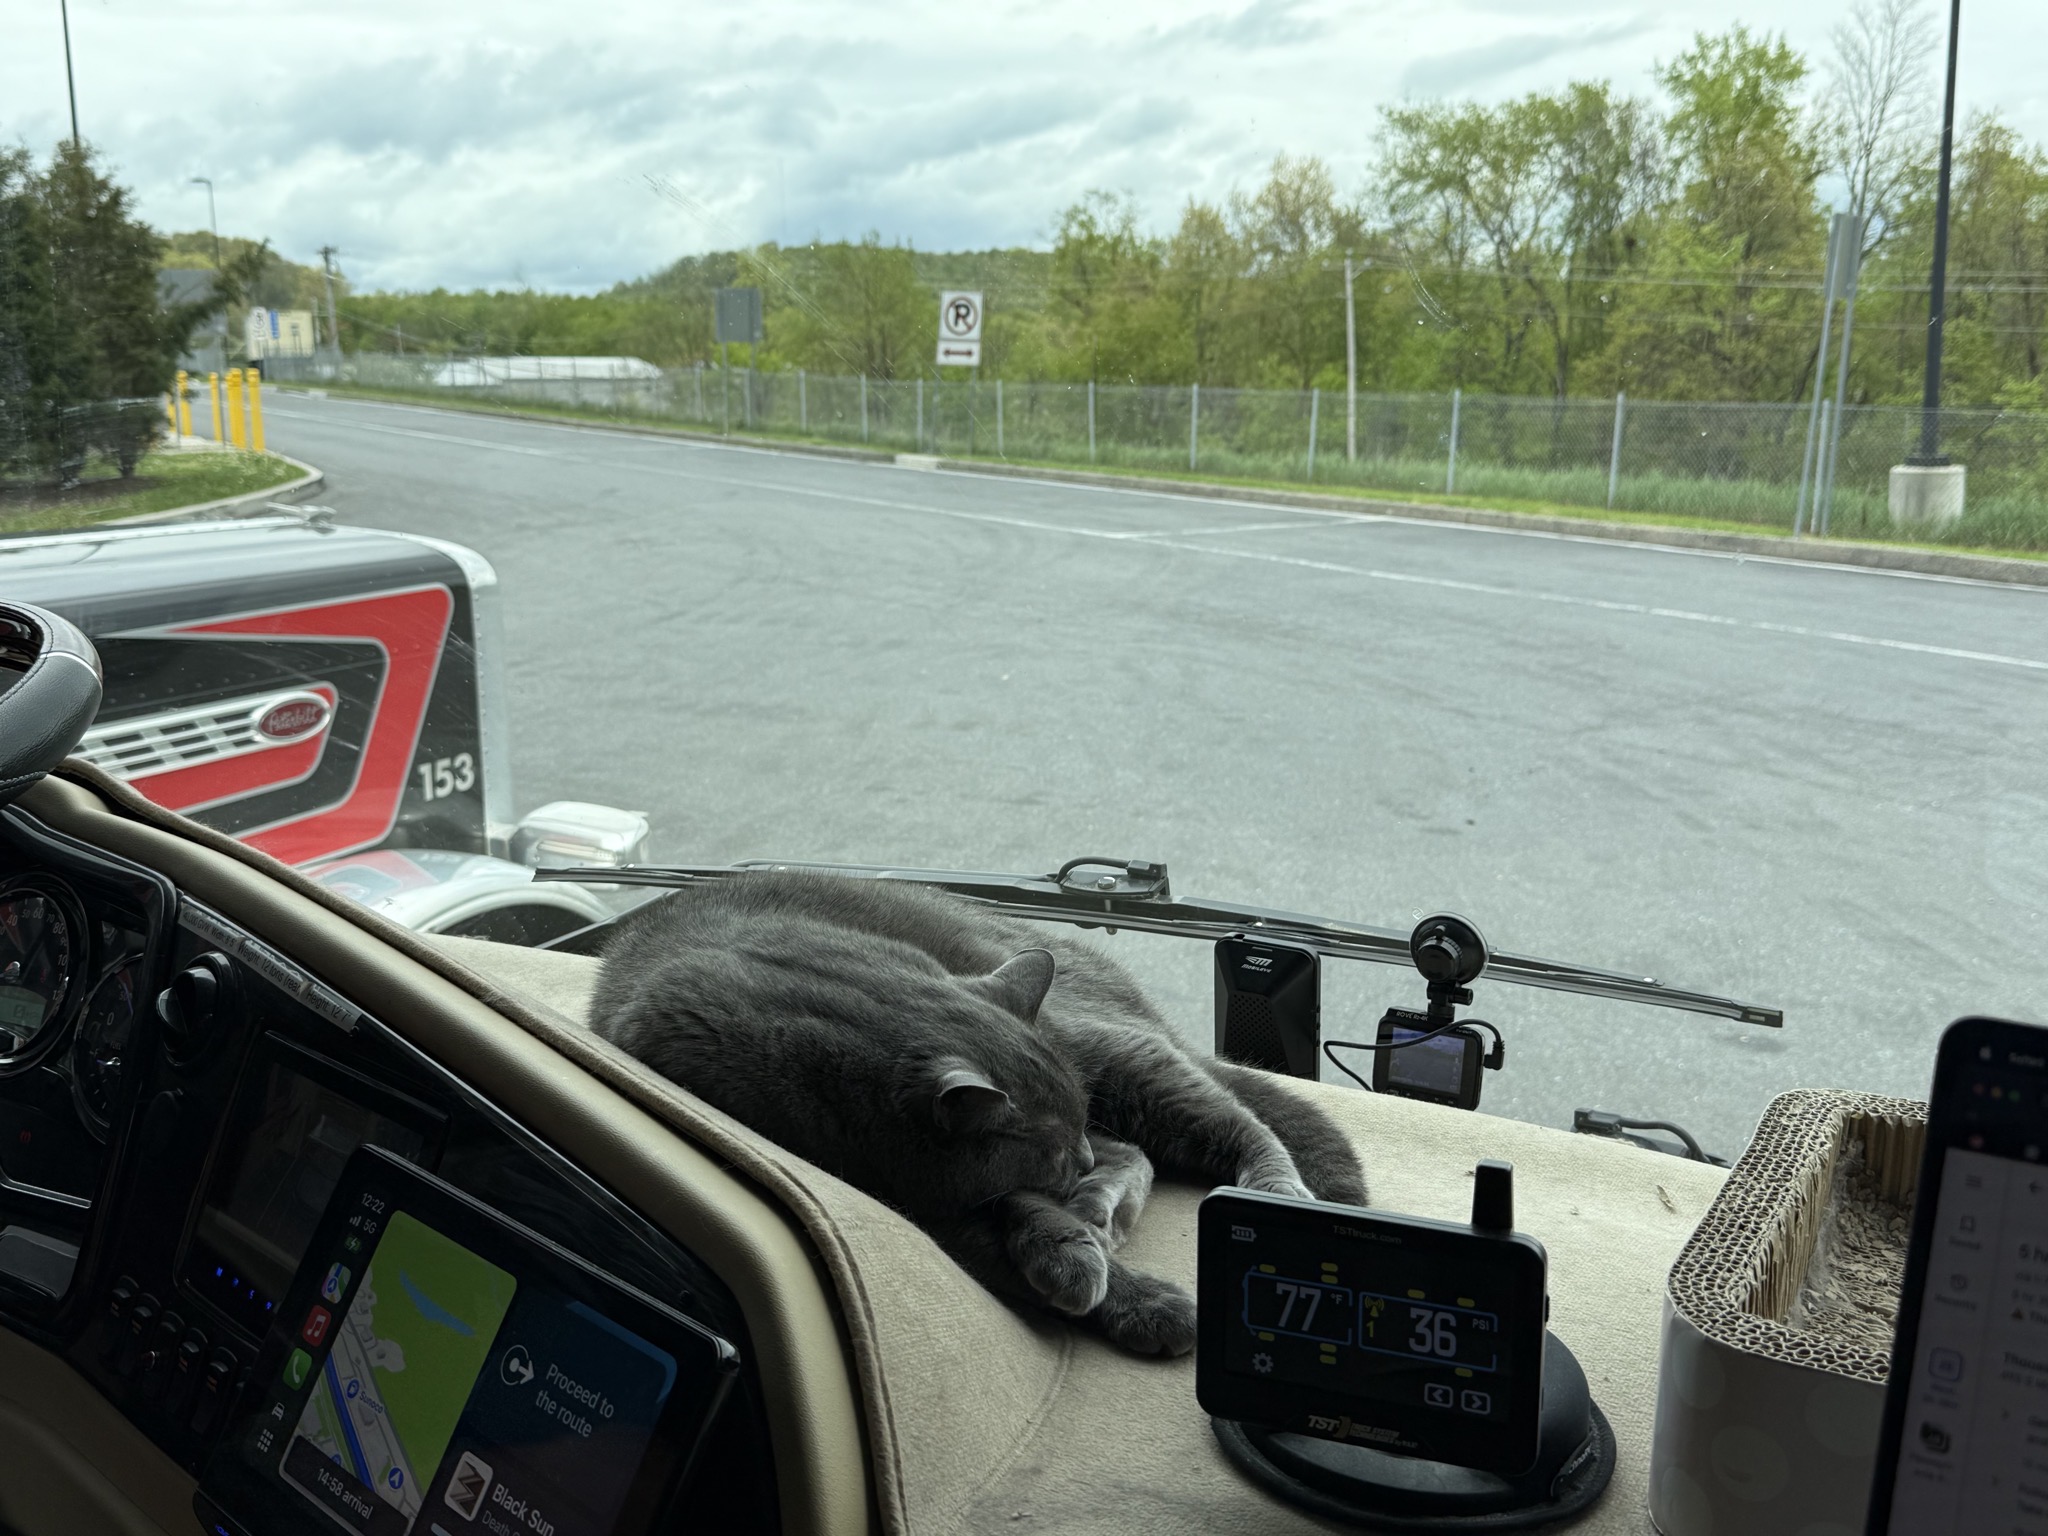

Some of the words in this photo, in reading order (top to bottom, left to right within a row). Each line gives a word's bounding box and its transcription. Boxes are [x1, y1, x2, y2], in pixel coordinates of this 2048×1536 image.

[417, 752, 476, 802] 153
[6, 914, 18, 927] 40
[33, 908, 45, 919] 60
[53, 921, 65, 935] 80
[237, 942, 261, 965] Weight:
[262, 957, 270, 973] 12
[268, 966, 284, 982] tons
[361, 1192, 385, 1215] 12:22
[363, 1218, 377, 1234] 5G
[1333, 1224, 1402, 1245] TSTtruck.com
[1275, 1281, 1322, 1332] 77
[1366, 1320, 1375, 1338] 1
[1408, 1307, 1457, 1358] 36
[1472, 1318, 1490, 1331] PSI
[359, 1391, 384, 1414] Sunoco
[546, 1363, 601, 1410] Proceed
[598, 1397, 615, 1419] to
[535, 1389, 557, 1415] the
[557, 1405, 593, 1438] route
[1308, 1414, 1341, 1432] TST
[316, 1468, 344, 1497] 14:58
[342, 1490, 374, 1519] arrival
[492, 1483, 529, 1522] Black
[528, 1508, 555, 1536] Sun
[481, 1510, 511, 1536] Death
